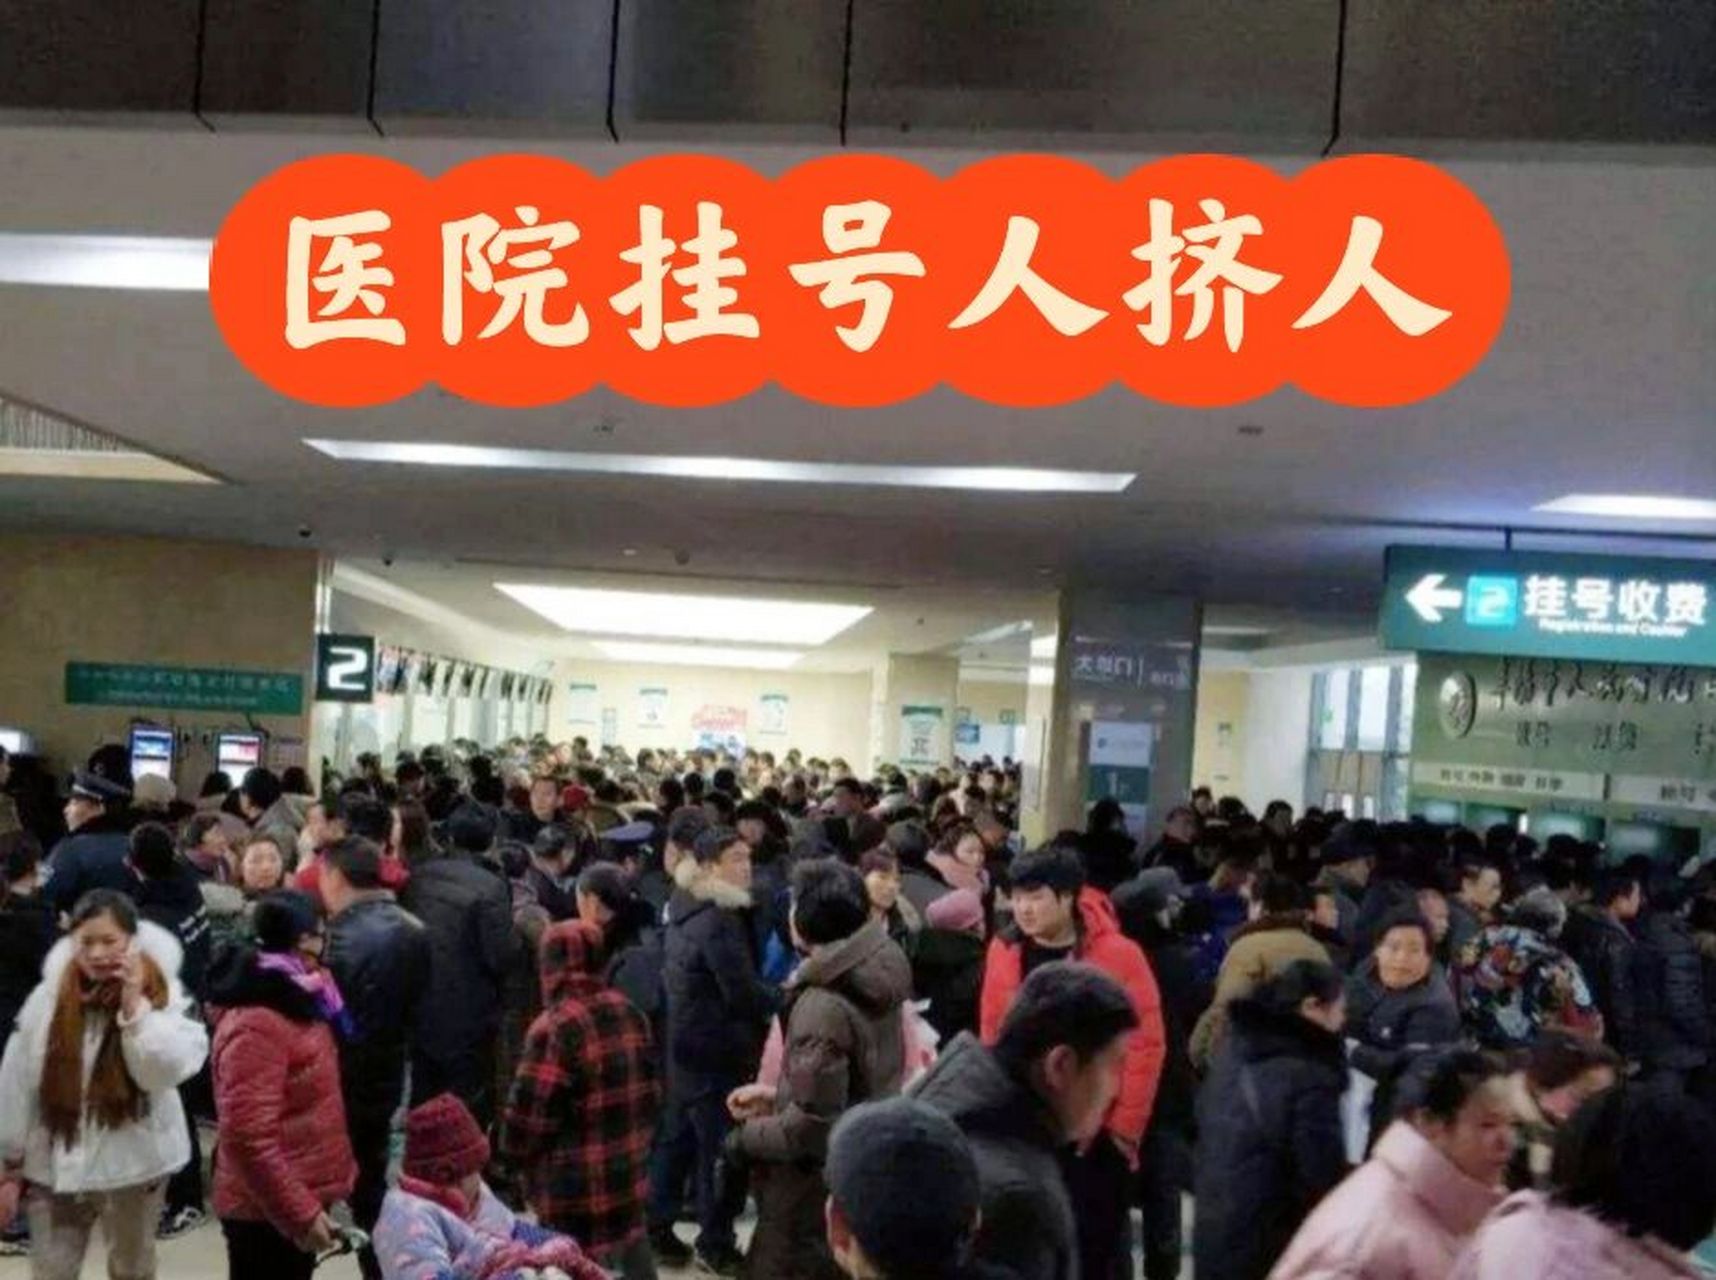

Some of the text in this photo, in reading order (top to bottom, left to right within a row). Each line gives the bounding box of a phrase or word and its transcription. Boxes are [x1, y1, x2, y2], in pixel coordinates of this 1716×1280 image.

[1478, 574, 1707, 626] 2 挂号收费
[327, 647, 368, 690] 2
